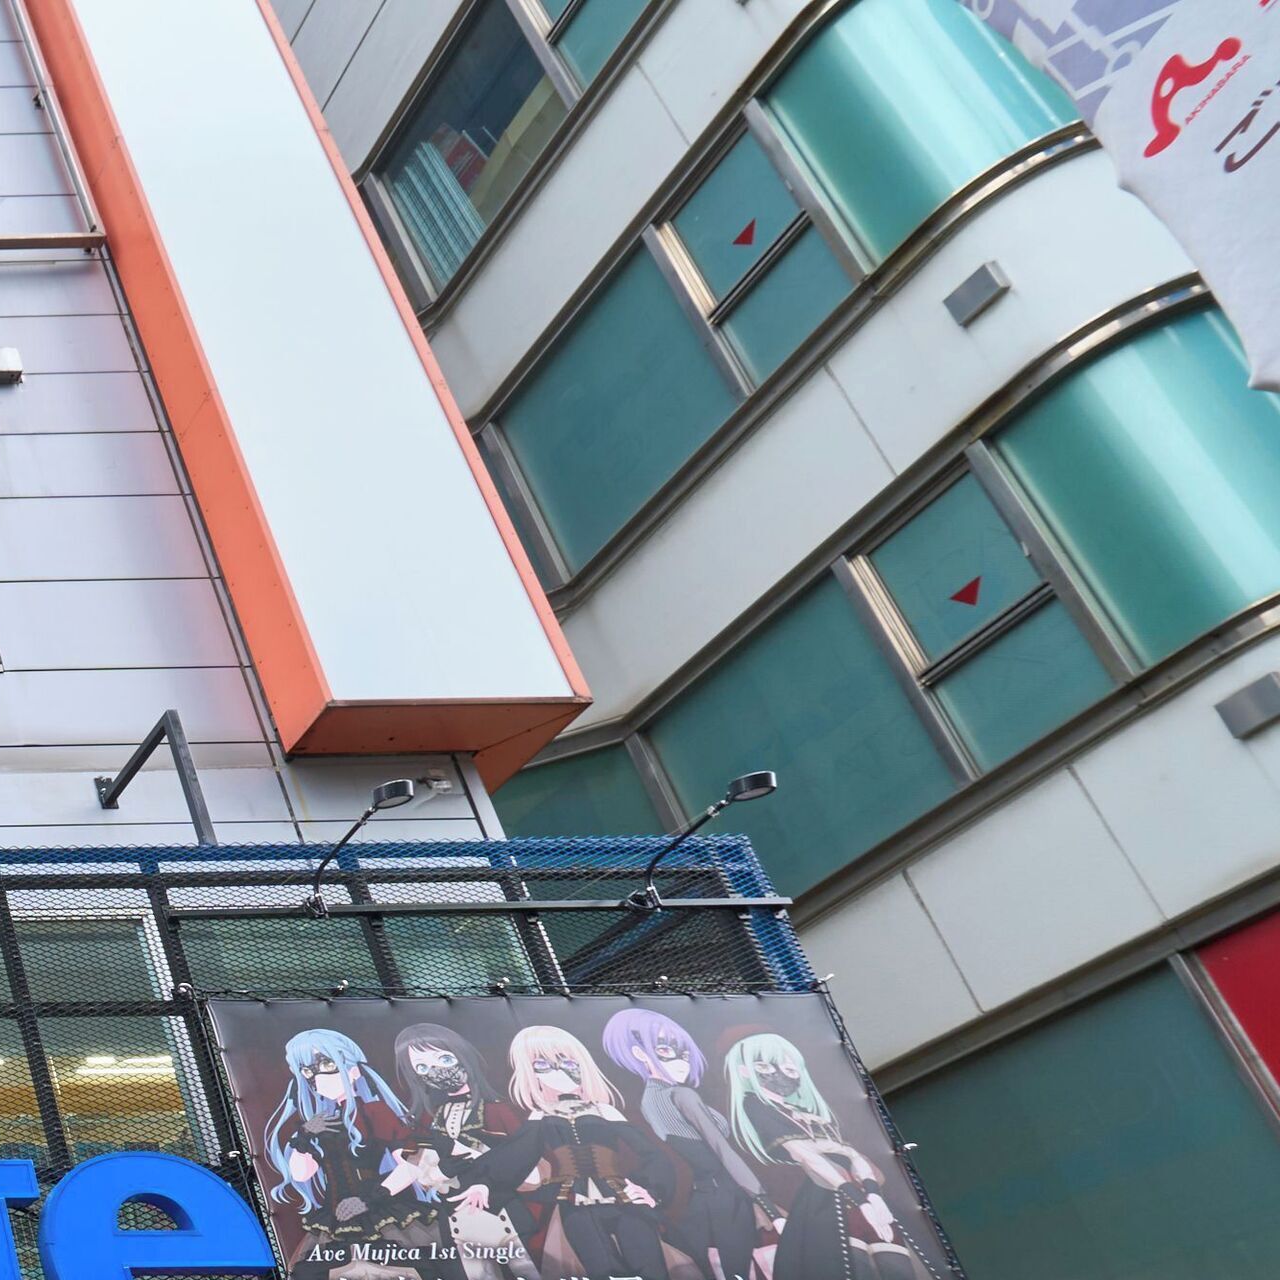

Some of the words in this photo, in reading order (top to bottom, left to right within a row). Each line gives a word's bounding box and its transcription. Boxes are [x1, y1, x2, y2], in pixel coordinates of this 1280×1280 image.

[306, 1243, 347, 1263] Ave
[350, 1241, 422, 1266] Mujica
[428, 1241, 457, 1262] 1st
[461, 1241, 526, 1266] Single
